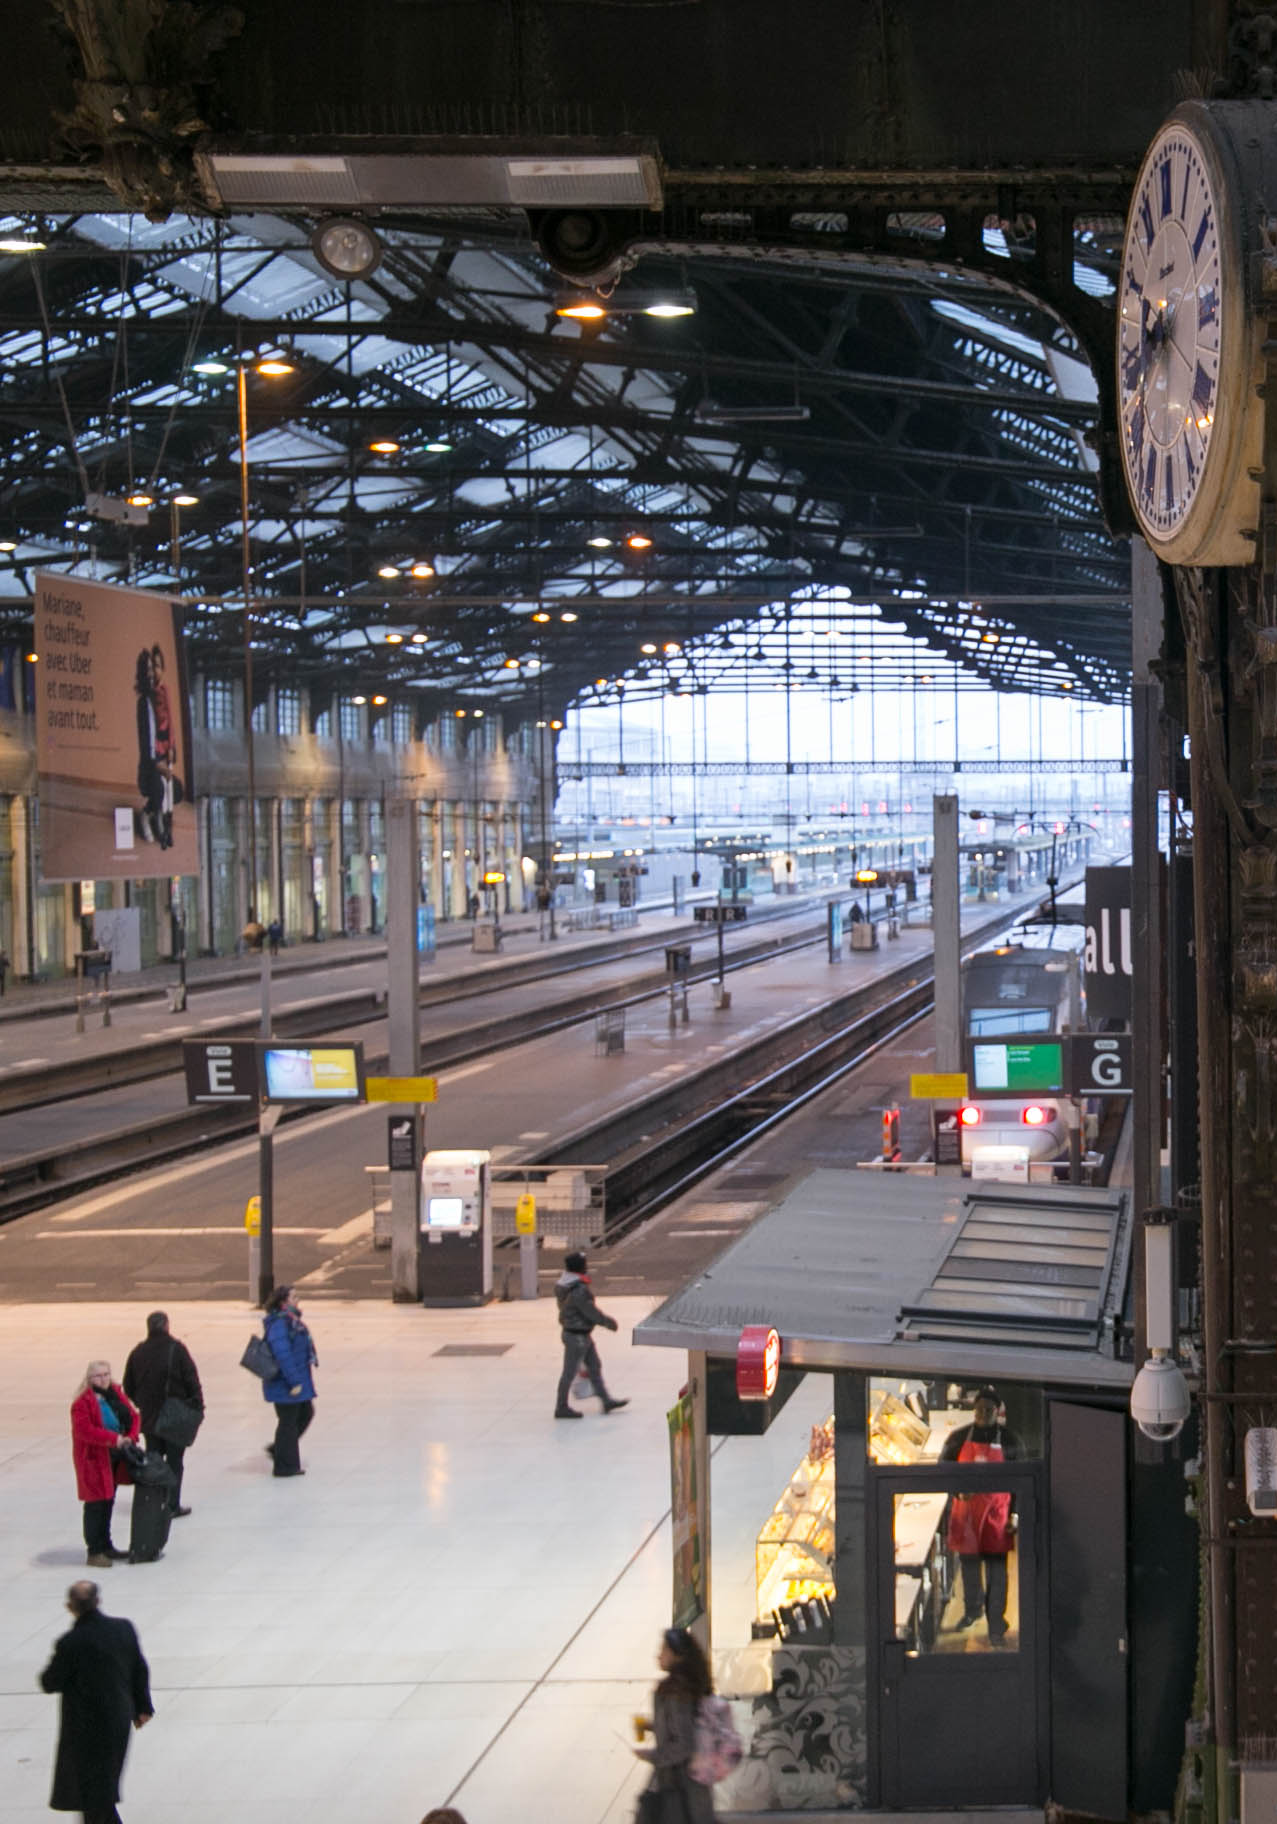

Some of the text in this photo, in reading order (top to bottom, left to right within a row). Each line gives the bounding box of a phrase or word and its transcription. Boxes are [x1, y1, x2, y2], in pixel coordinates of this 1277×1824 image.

[45, 618, 90, 647] chauffeur
[46, 652, 92, 674] avec Uber
[47, 681, 94, 702] et maman
[48, 710, 74, 729] avant
[207, 1059, 235, 1093] E
[1091, 1053, 1122, 1086] G
